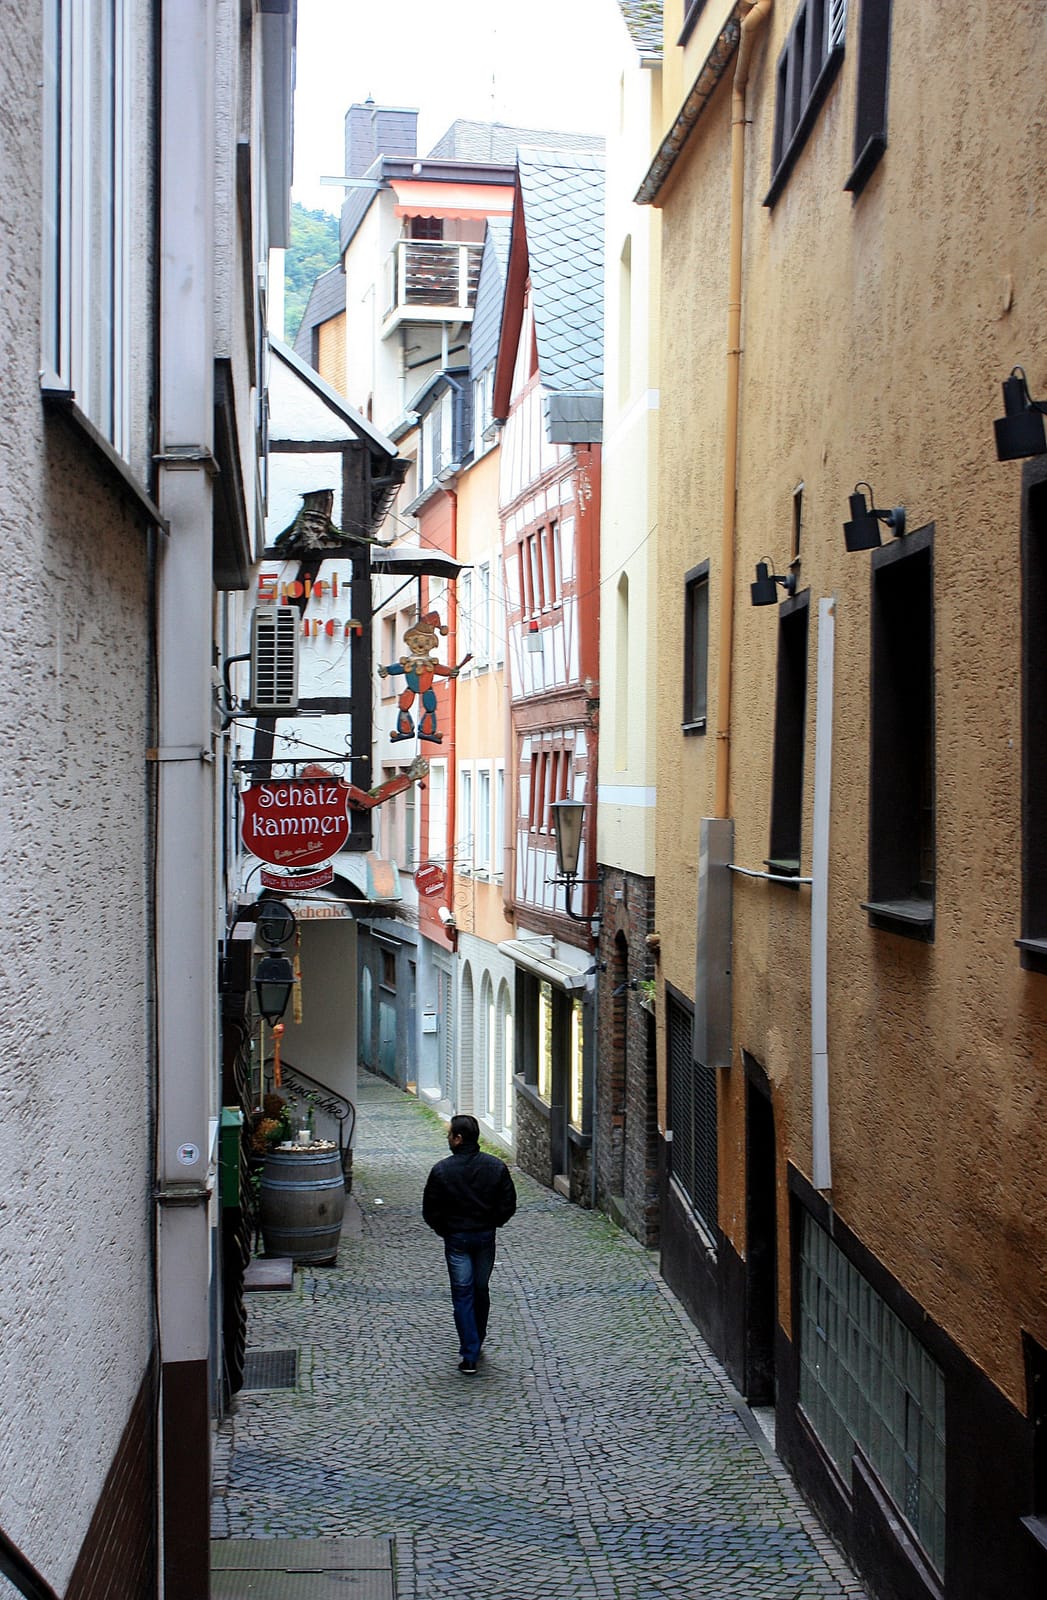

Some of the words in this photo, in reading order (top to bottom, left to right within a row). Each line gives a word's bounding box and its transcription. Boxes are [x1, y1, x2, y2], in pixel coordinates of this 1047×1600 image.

[258, 572, 352, 606] Spiel-
[258, 783, 339, 808] Schatz
[252, 812, 347, 837] kammer
